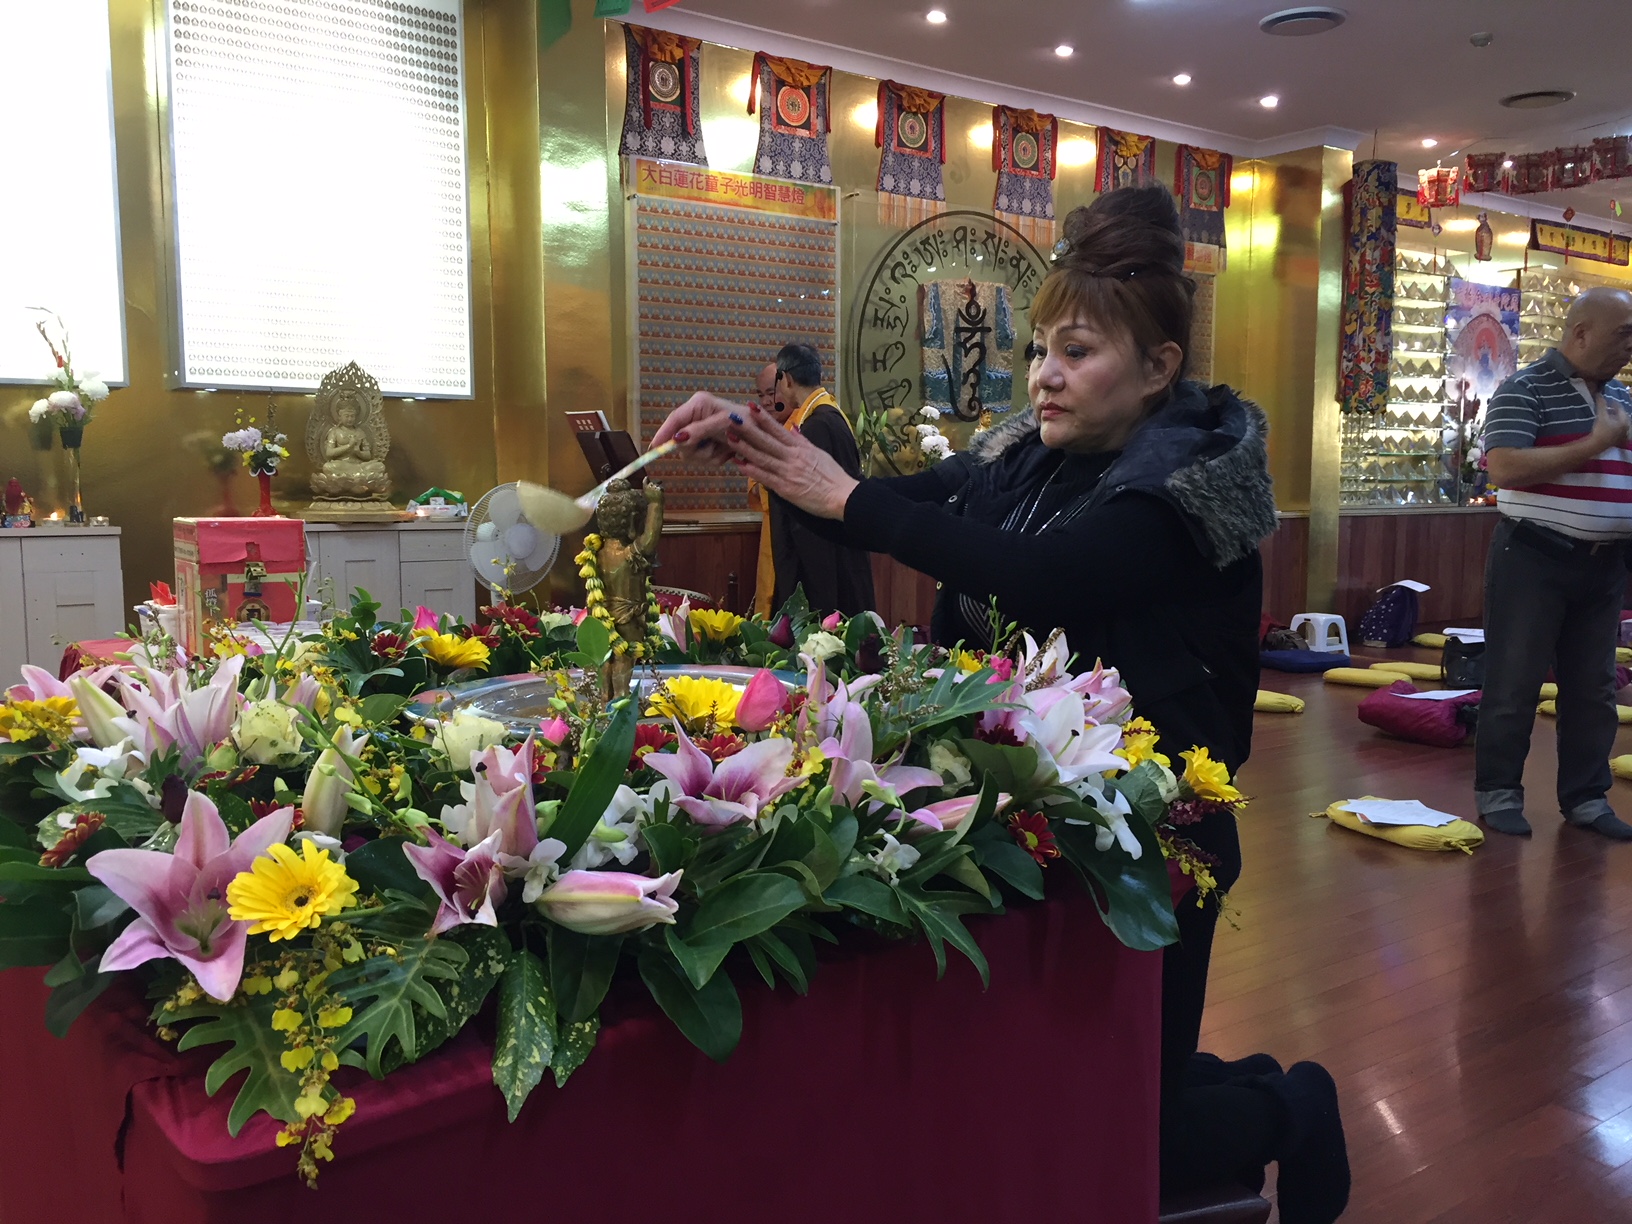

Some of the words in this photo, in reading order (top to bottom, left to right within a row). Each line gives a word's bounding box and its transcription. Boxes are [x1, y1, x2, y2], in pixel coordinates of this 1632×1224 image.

[642, 165, 806, 205] 大白蓮花童子光明智慧燈
